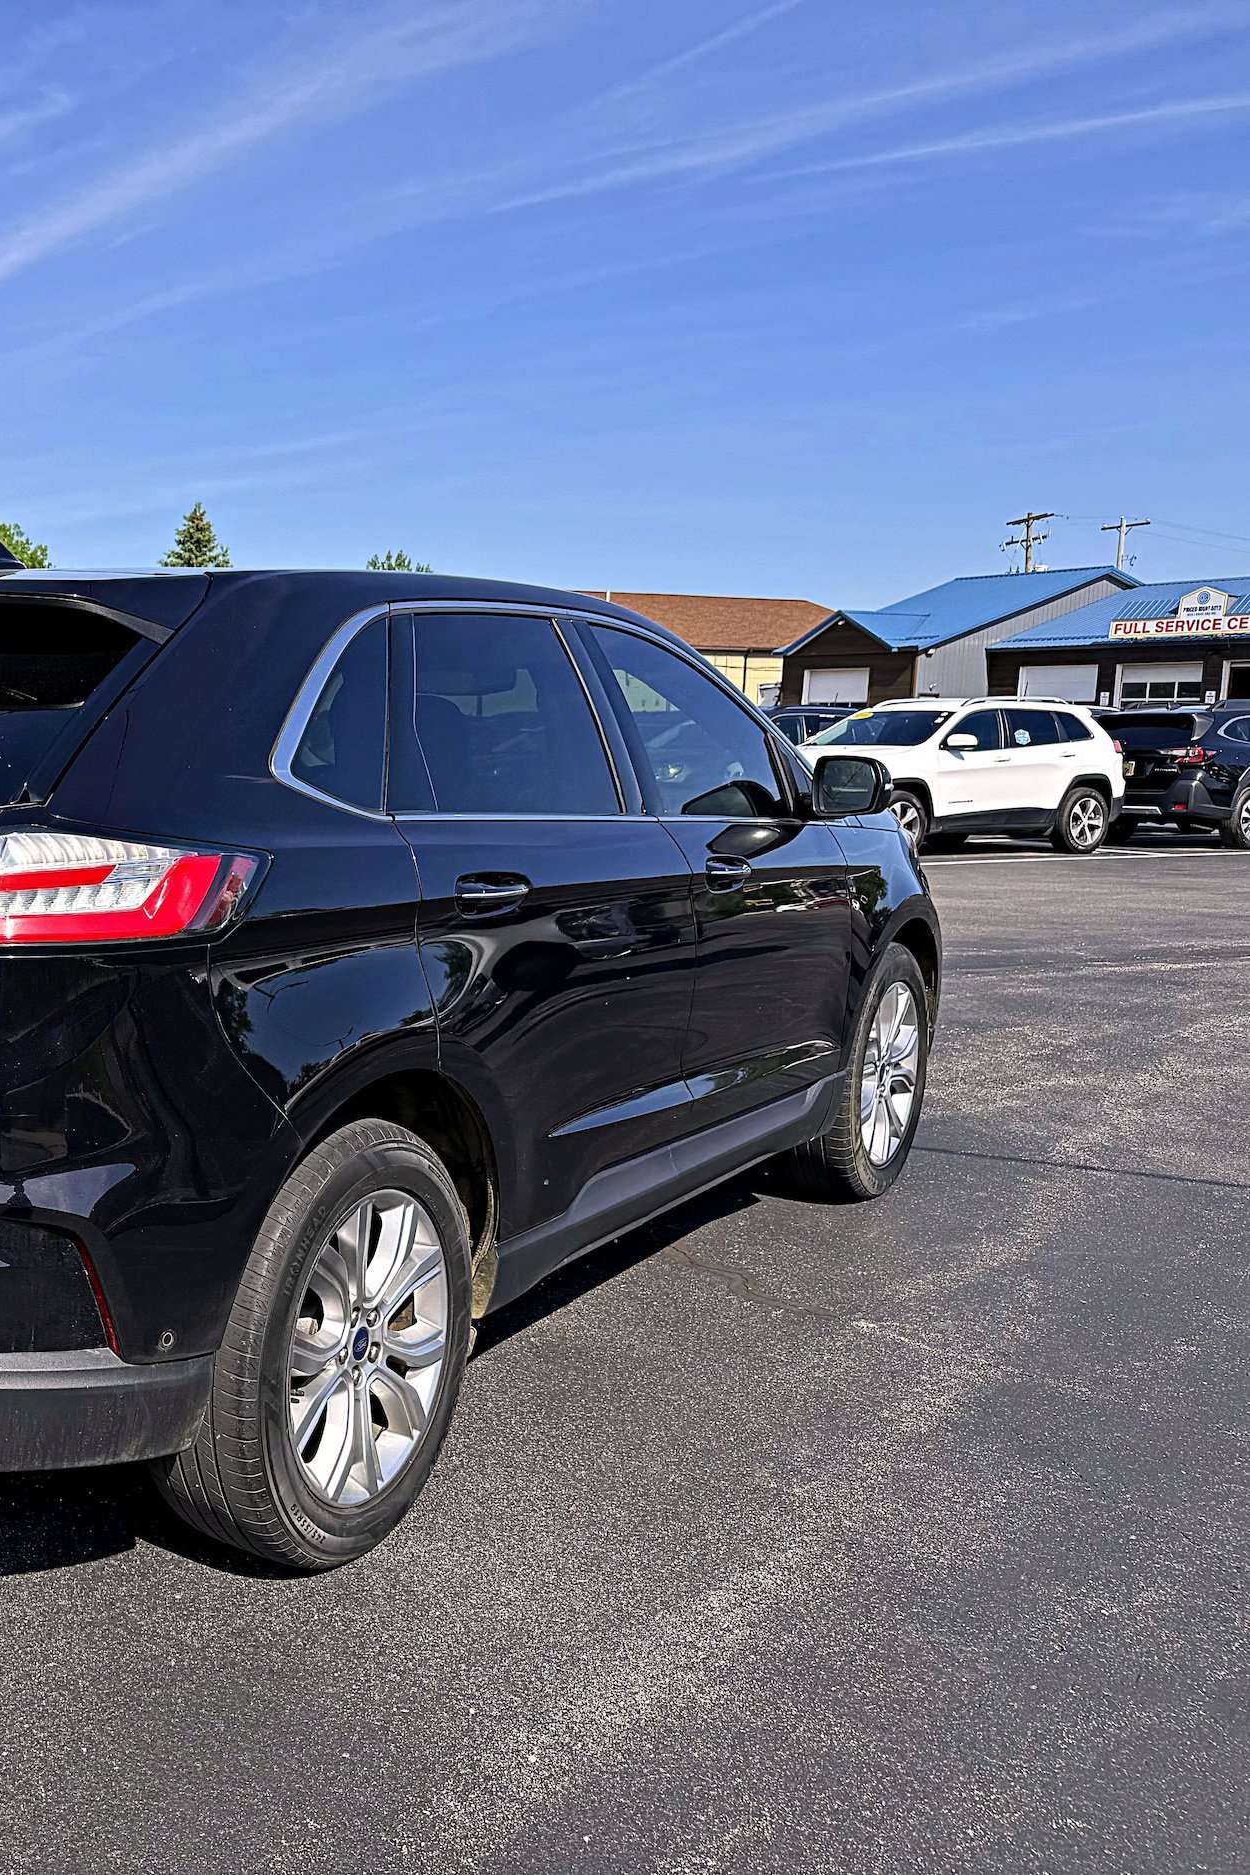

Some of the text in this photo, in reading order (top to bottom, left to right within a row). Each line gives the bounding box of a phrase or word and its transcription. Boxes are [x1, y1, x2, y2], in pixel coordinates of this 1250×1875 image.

[1114, 622, 1150, 635] FULL
[1154, 617, 1223, 634] SERVICE
[290, 1503, 327, 1544] 245/55R19
